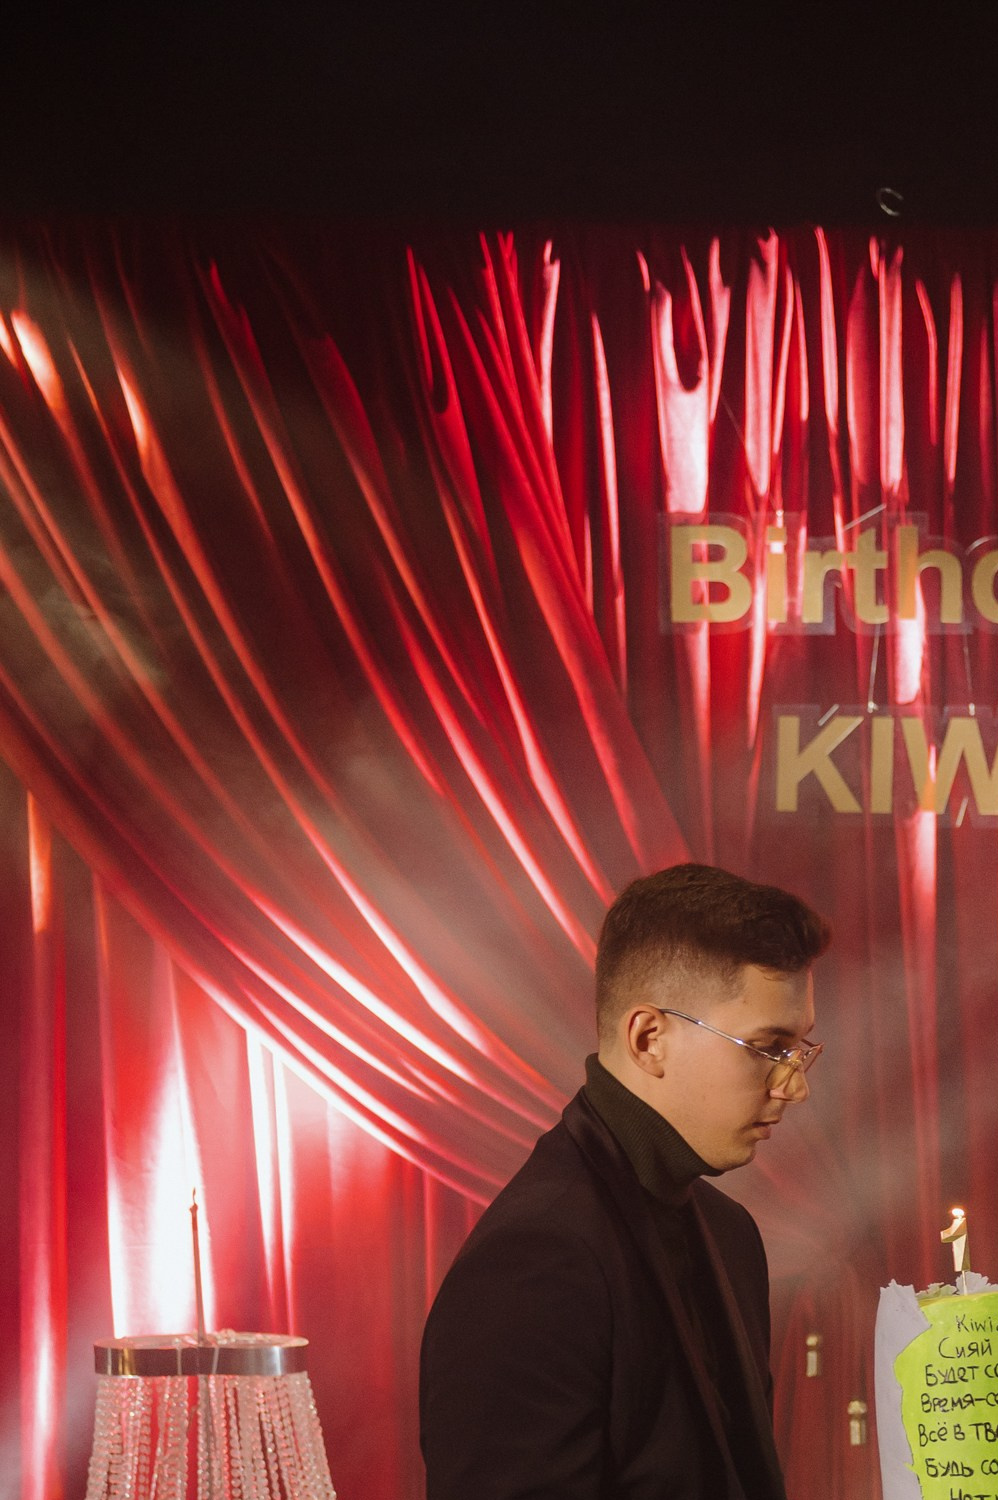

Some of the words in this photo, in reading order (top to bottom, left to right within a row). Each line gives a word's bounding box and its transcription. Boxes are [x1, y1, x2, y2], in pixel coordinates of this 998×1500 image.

[940, 1216, 971, 1273] 1
[955, 1313, 994, 1333] Kiwi
[938, 1336, 993, 1359] Сияй
[924, 1363, 980, 1388] Будет
[917, 1421, 949, 1448] Всё
[924, 1457, 975, 1478] Будь
